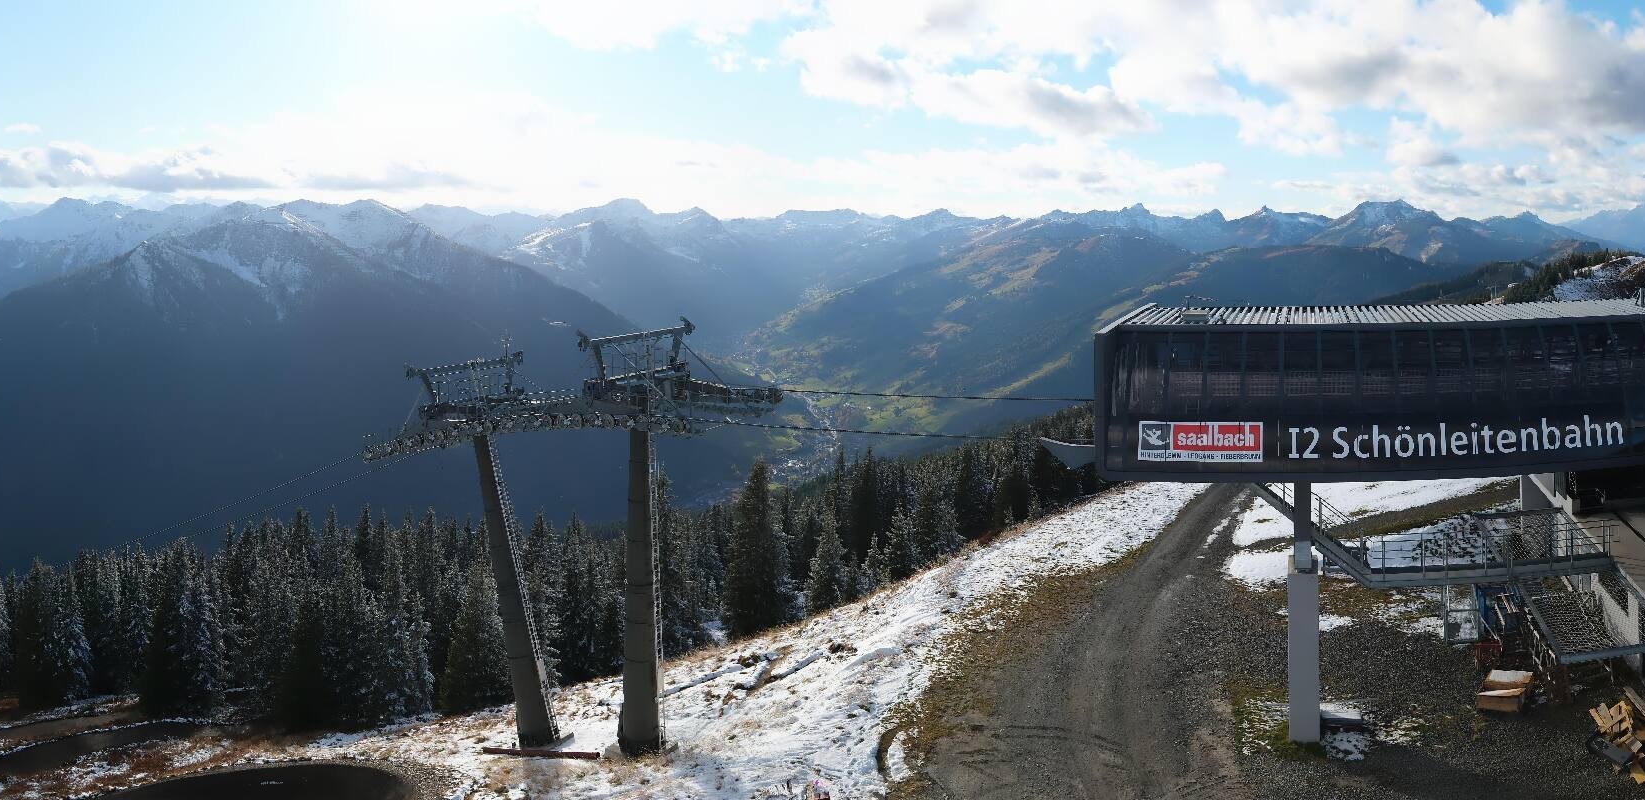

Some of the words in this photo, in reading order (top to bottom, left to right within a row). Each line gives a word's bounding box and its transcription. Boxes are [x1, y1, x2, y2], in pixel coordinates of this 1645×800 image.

[1177, 424, 1255, 446] saalbach
[1288, 427, 1320, 459] I2
[1332, 415, 1624, 459] Schönleitenbahn
